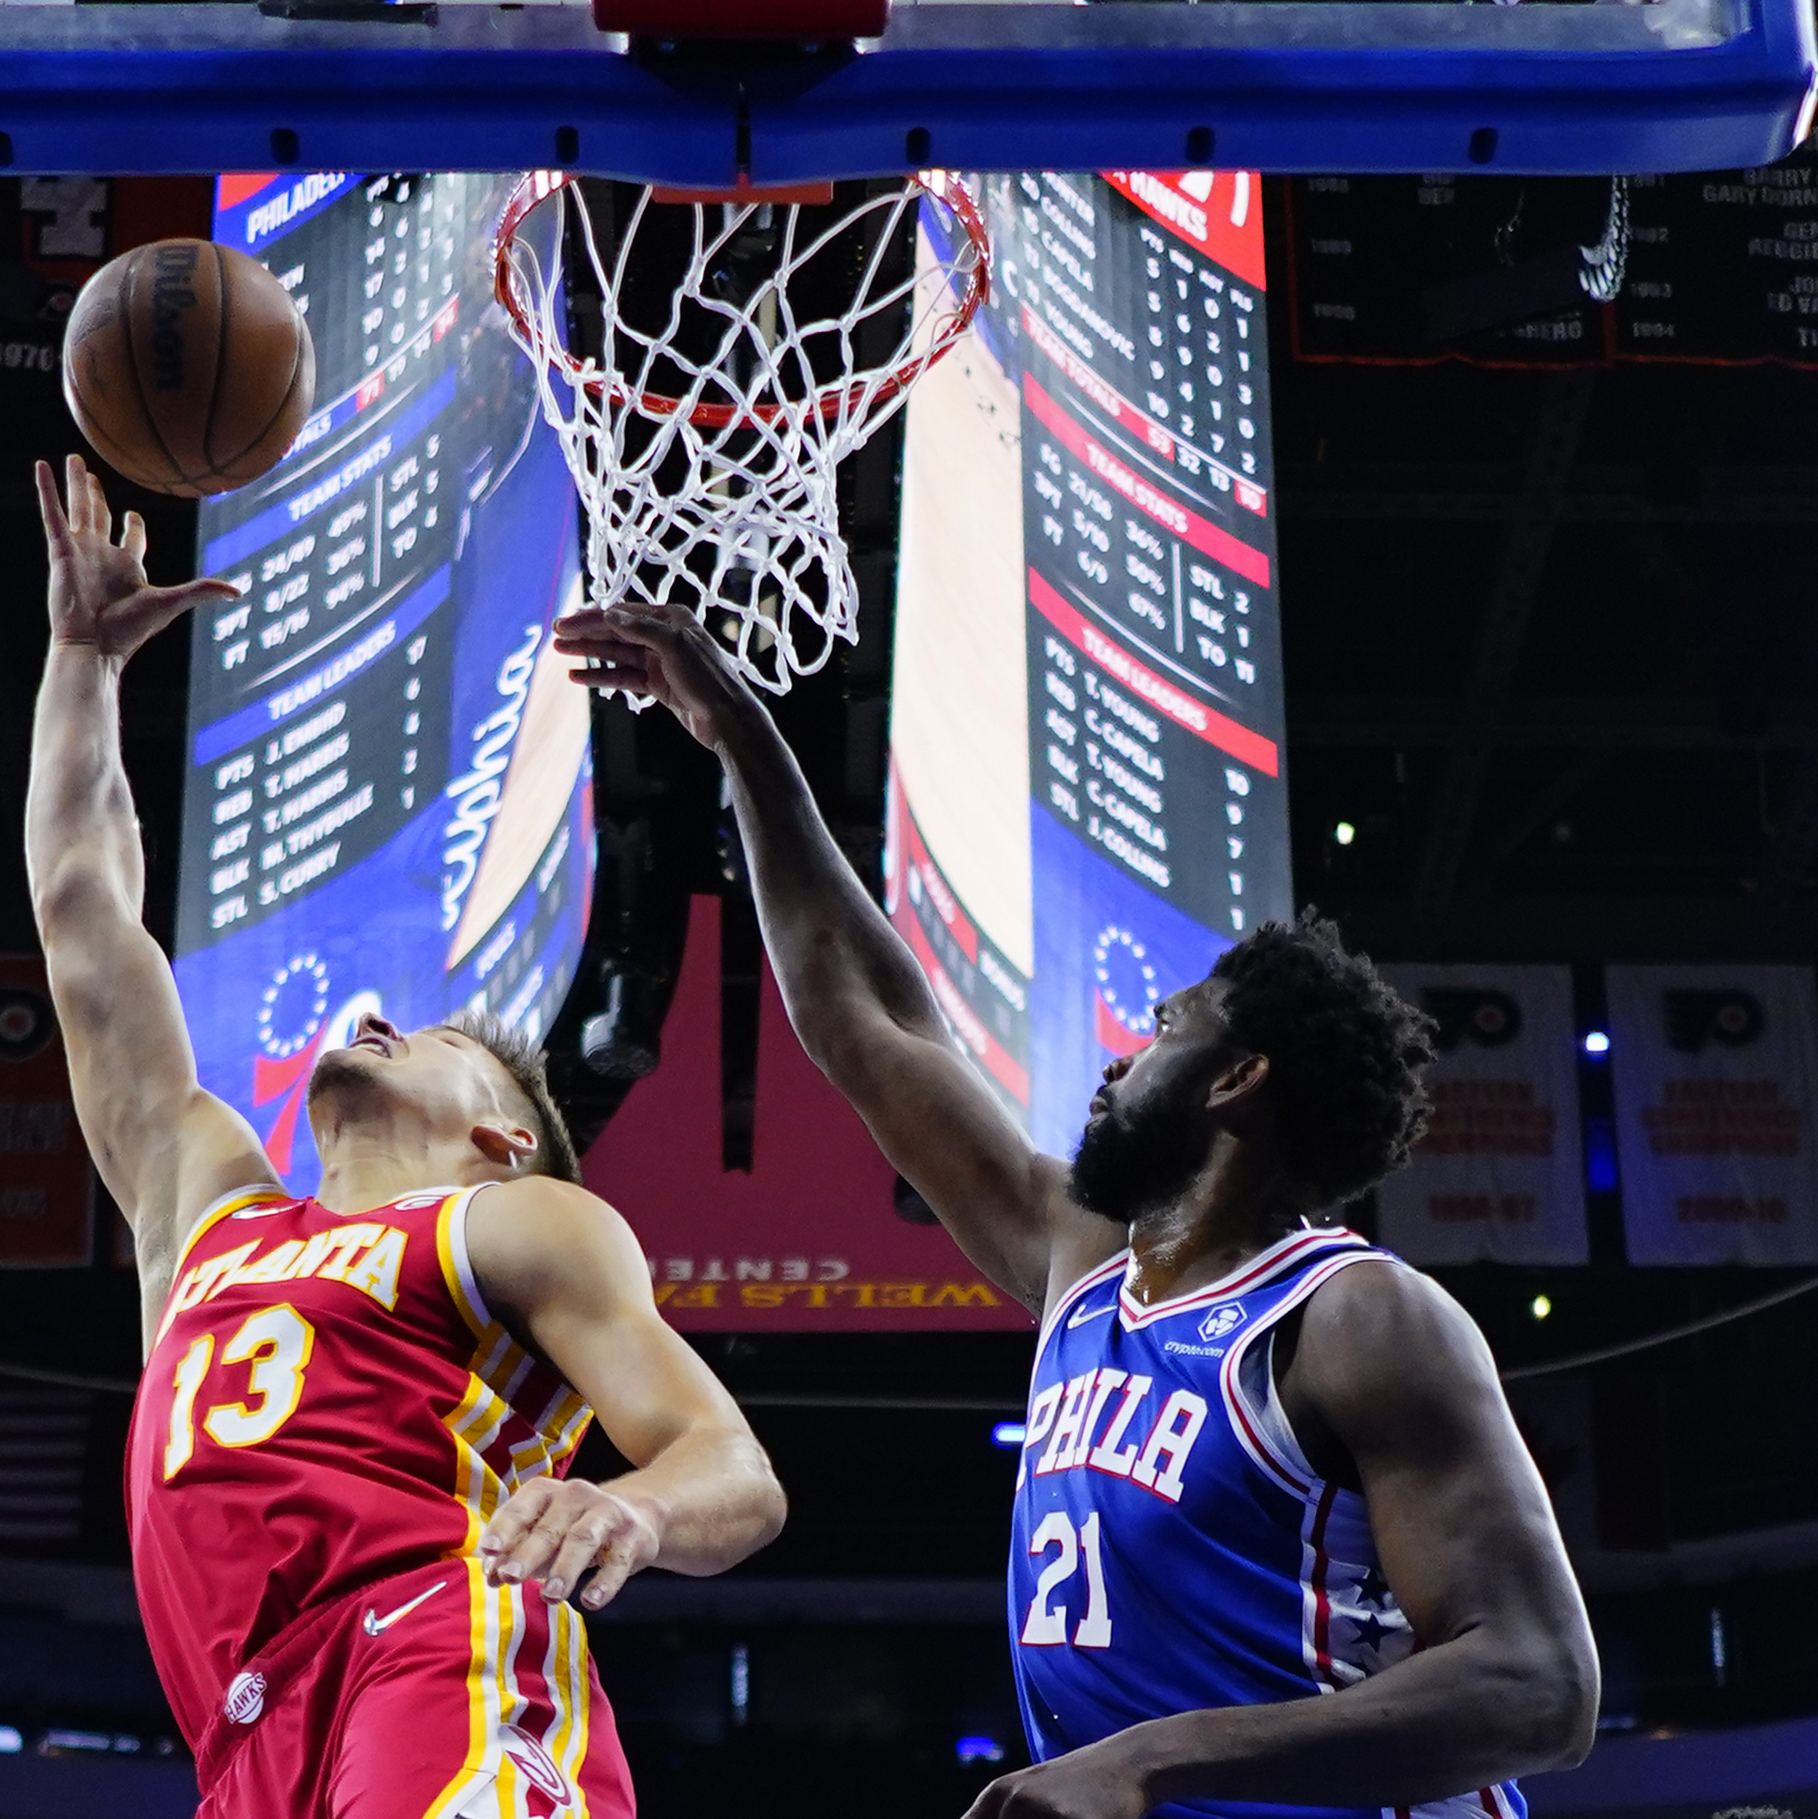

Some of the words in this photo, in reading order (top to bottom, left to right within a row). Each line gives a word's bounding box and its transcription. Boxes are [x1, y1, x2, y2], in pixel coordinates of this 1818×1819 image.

[341, 433, 393, 489] STATS
[1134, 481, 1189, 534] STATS
[1197, 634, 1228, 668] TO
[1130, 666, 1208, 732] LEADERS
[154, 1223, 409, 1351] ATLANTA
[653, 1253, 851, 1282] CENTE
[740, 1280, 1003, 1310] WELLS
[1163, 1340, 1225, 1358] crypto.com
[163, 1302, 316, 1482] 13
[1017, 1367, 1208, 1504] PHILA
[1019, 1512, 1113, 1649] 21
[225, 1672, 268, 1724] HAWKS
